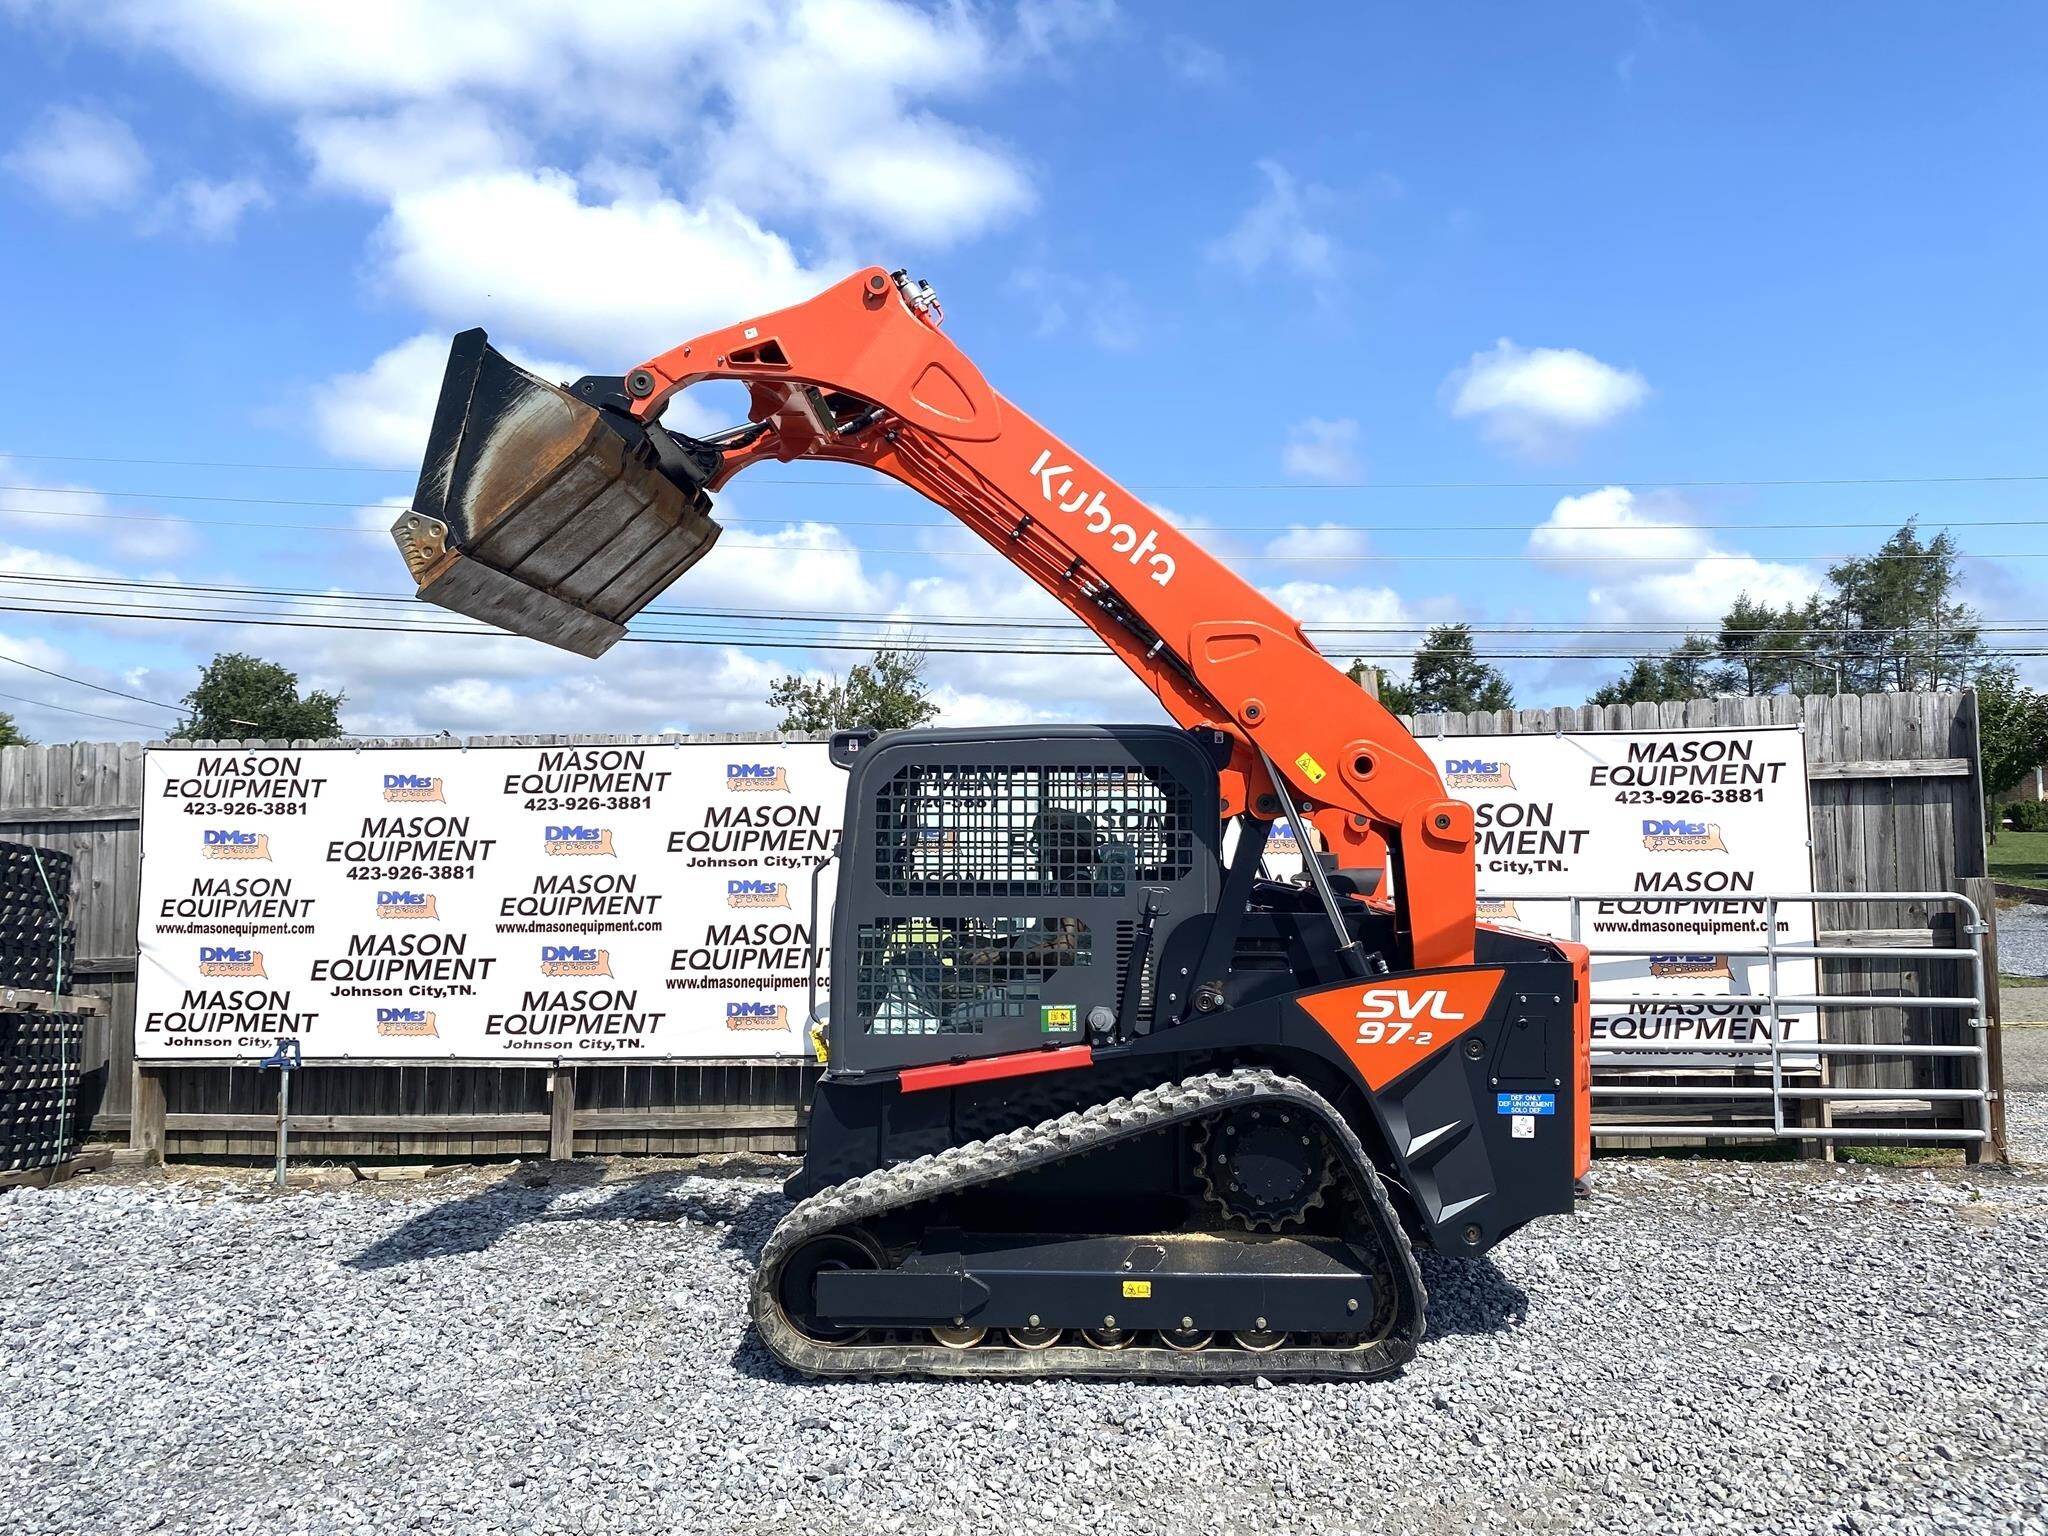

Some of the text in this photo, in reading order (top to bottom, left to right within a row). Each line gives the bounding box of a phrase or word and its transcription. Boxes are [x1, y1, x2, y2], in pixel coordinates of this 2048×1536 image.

[1029, 449, 1176, 587] Kubota
[538, 751, 645, 771] MASON
[1628, 740, 1752, 763] MASON
[197, 757, 301, 776] MASON
[1590, 762, 1786, 786] EQUIPMENT
[163, 779, 327, 798] EQUIPMENT
[504, 772, 671, 794] EQUIPMENT
[524, 796, 650, 811] 423-926-3881
[1615, 788, 1763, 804] 423-926-3881
[184, 802, 306, 815] 423-926-3881
[704, 806, 821, 827] MASON
[1474, 803, 1553, 828] SON
[361, 817, 469, 838] MASON
[326, 840, 496, 862] EQUIPMENT
[687, 857, 757, 867] Johnson
[347, 866, 474, 880] 423-926-3881
[1634, 871, 1753, 891] MASON
[192, 878, 291, 897] MASON
[533, 874, 636, 894] MASON
[161, 899, 315, 917] EQUIPMENT
[500, 896, 662, 916] EQUIPMENT
[156, 922, 314, 937] www.dmasonequipment.com
[496, 920, 662, 935] www.dmasonequipment.com
[704, 923, 812, 946] MASON
[1593, 920, 1789, 935] www.dmasonequipment.cm
[348, 934, 466, 956] MASON
[311, 958, 496, 981] EQUIPMENT
[181, 990, 290, 1010] MASON
[330, 986, 402, 996] Johnson
[522, 990, 637, 1011] MASON
[1355, 989, 1465, 1020] SVL
[145, 1012, 319, 1032] EQUIPMENT
[485, 1013, 666, 1035] EQUIPMENT
[1591, 1016, 1799, 1040] EQUIPMENT
[164, 1037, 232, 1046] Johnson
[1355, 1022, 1433, 1045] 97-2
[503, 1040, 572, 1049] Johnson
